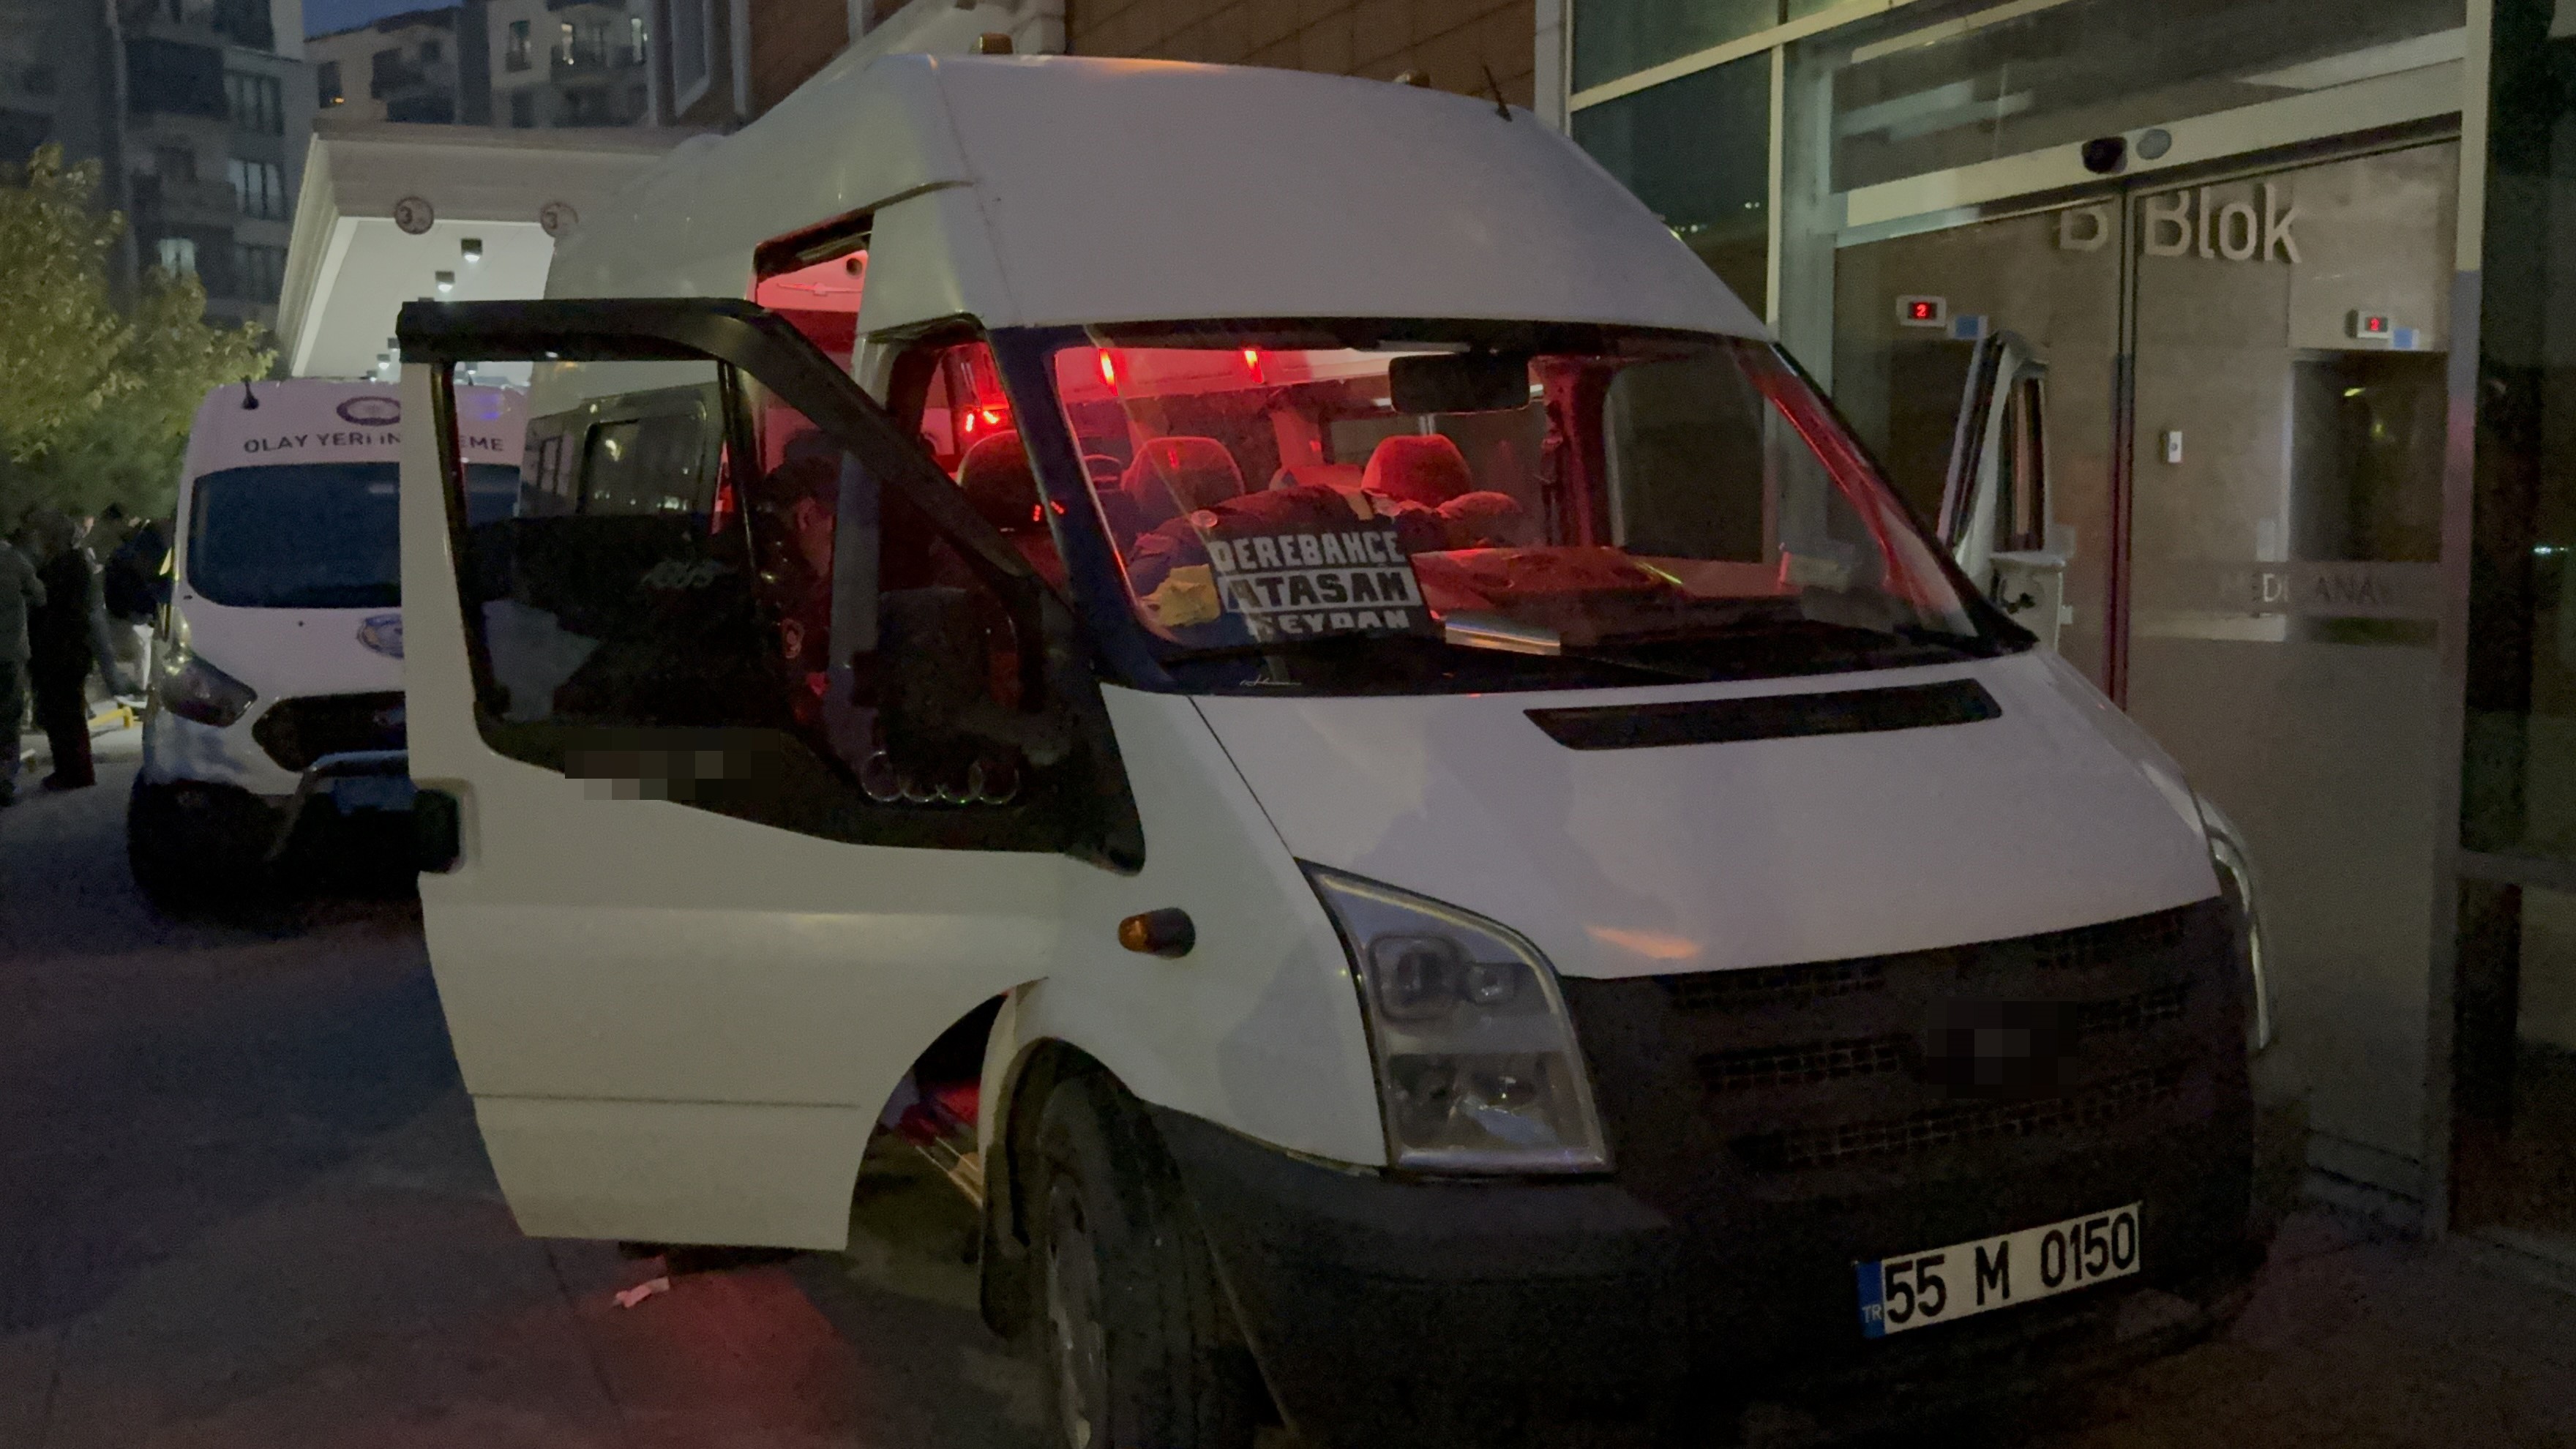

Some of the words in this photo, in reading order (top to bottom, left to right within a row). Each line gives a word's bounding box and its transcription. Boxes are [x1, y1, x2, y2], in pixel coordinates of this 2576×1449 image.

[2144, 184, 2302, 263] Blok
[1916, 303, 1928, 318] 2
[244, 433, 308, 454] OLAY
[1227, 572, 1409, 610] ATASAM
[1885, 1253, 1947, 1324] 55
[1976, 1240, 2010, 1306] M
[2040, 1212, 2136, 1288] 0150
[1861, 1303, 1884, 1325] TR
